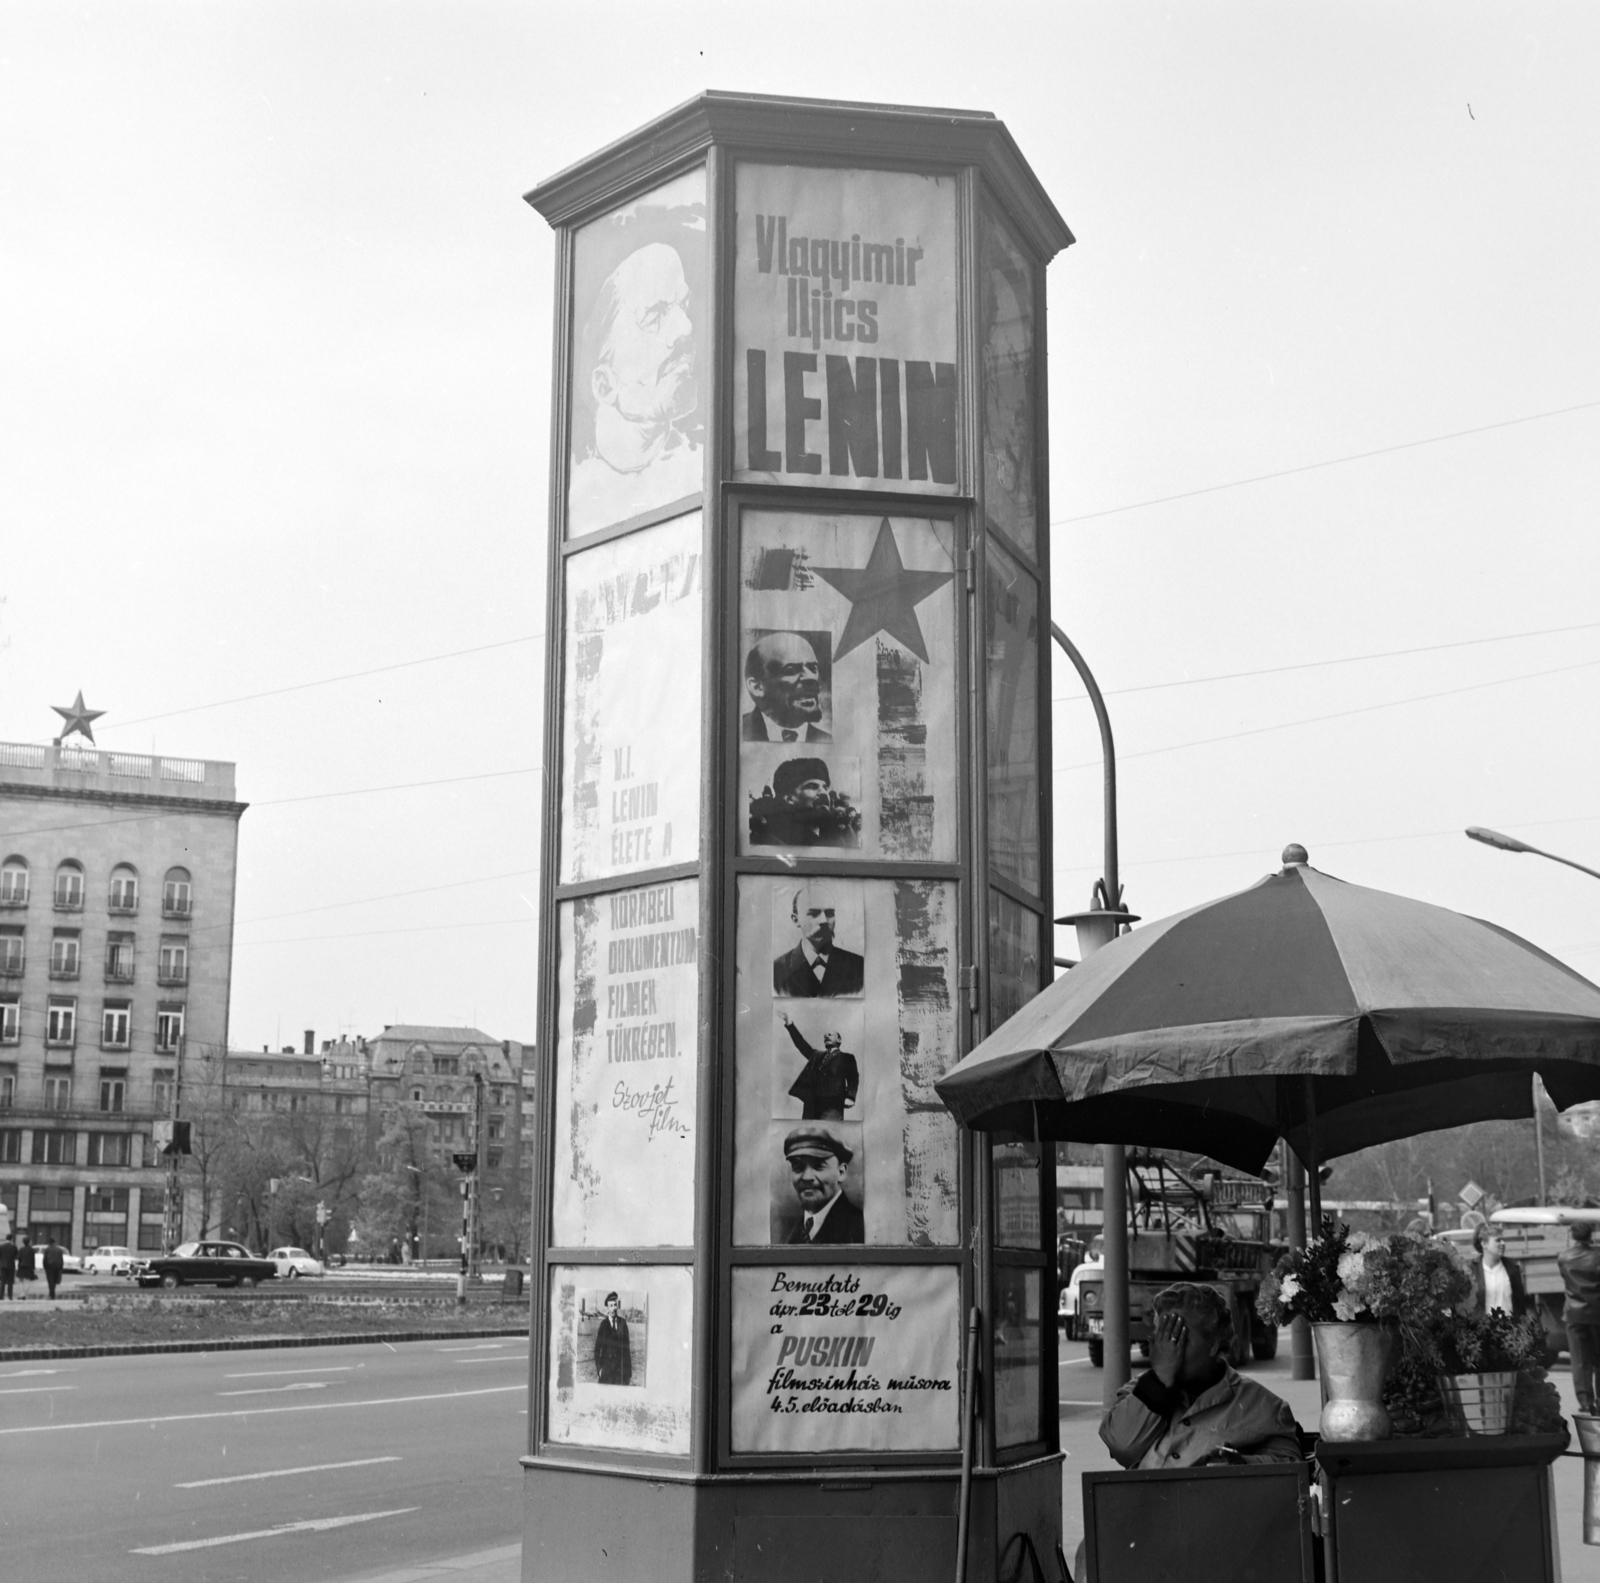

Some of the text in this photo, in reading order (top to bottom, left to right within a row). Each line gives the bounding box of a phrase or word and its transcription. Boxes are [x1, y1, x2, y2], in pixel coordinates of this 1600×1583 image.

[787, 277, 879, 350] Iljics
[746, 348, 957, 484] LENIN
[613, 745, 635, 781] V.I.
[612, 781, 659, 824] LENIN
[611, 821, 673, 866] ÉLETE A
[610, 886, 675, 931] KORABELI
[608, 927, 697, 975] DOKUMENTUM
[607, 978, 658, 1019] FILMEK
[612, 1075, 679, 1118] Szovjet
[648, 1104, 692, 1142] film
[770, 1271, 861, 1294] Bemutató
[770, 1323, 784, 1335] a
[776, 1335, 877, 1368] PUSKIN
